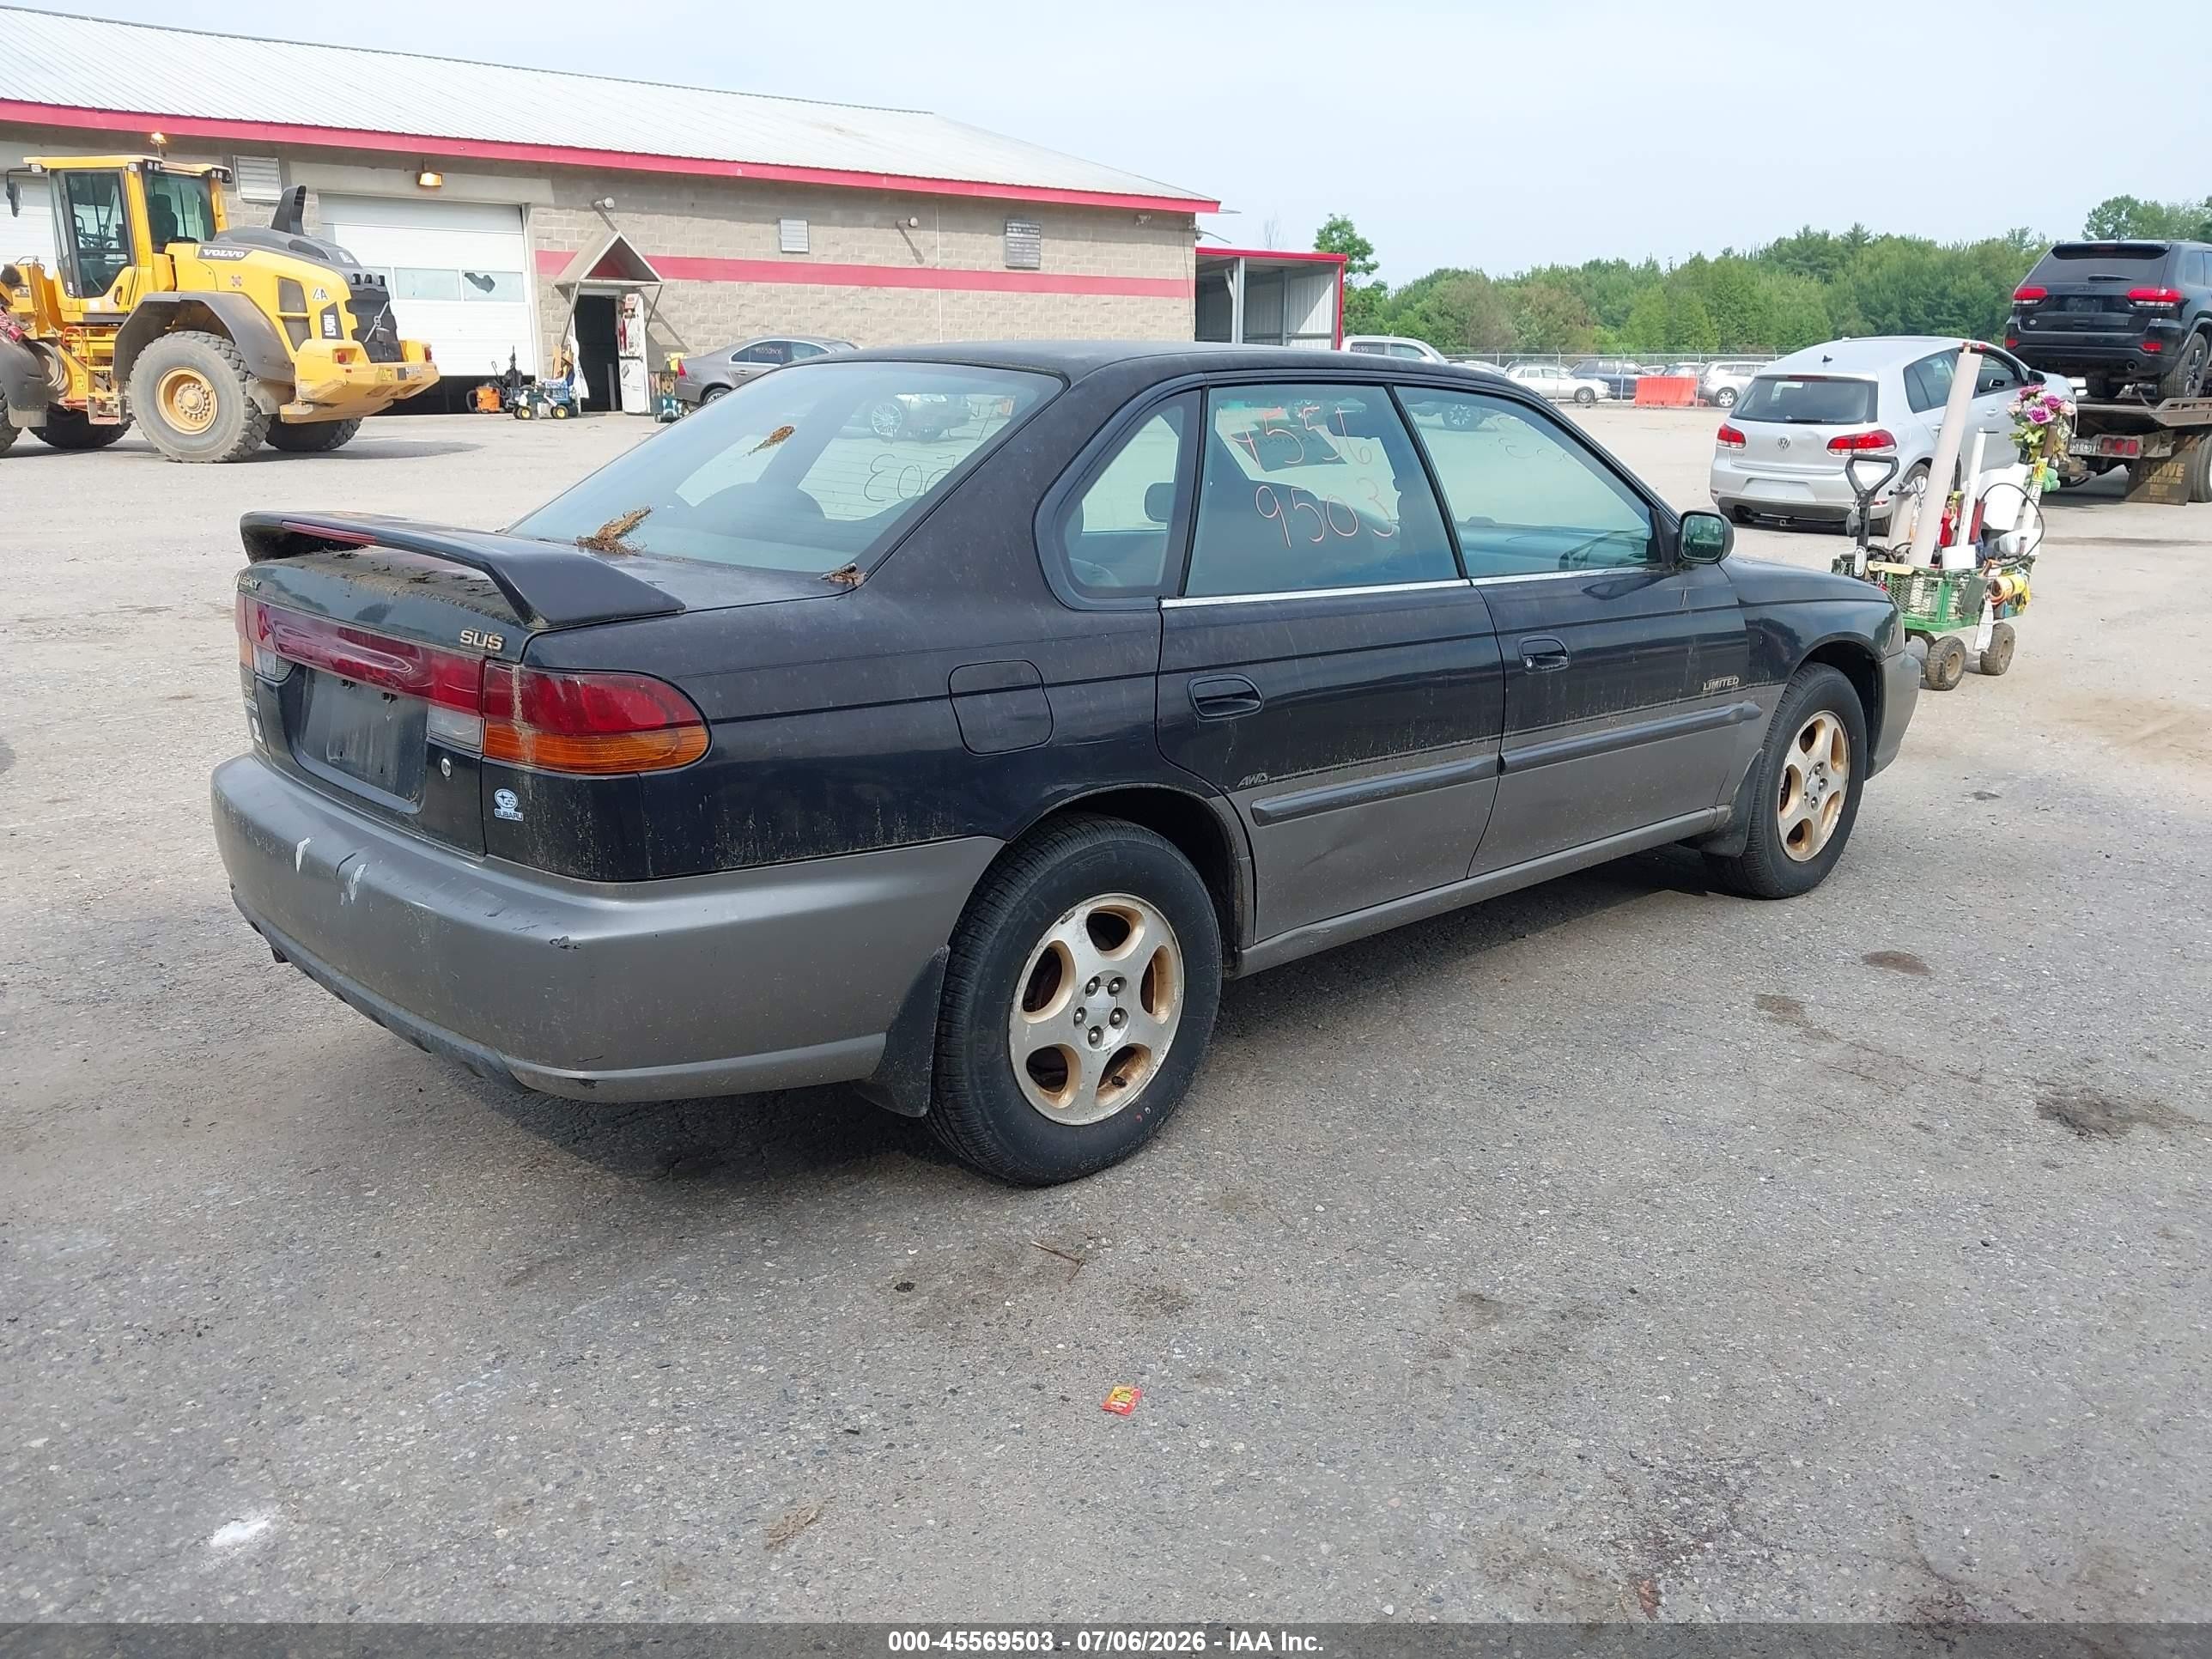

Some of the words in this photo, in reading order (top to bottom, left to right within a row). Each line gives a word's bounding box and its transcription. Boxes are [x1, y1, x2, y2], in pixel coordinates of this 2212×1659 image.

[203, 249, 246, 258] VOLVO
[1255, 477, 1395, 548] 9503
[459, 629, 504, 651] SUS
[1702, 676, 1740, 690] LIMITED
[1237, 773, 1268, 787] AWD
[494, 807, 523, 820] SUBARU
